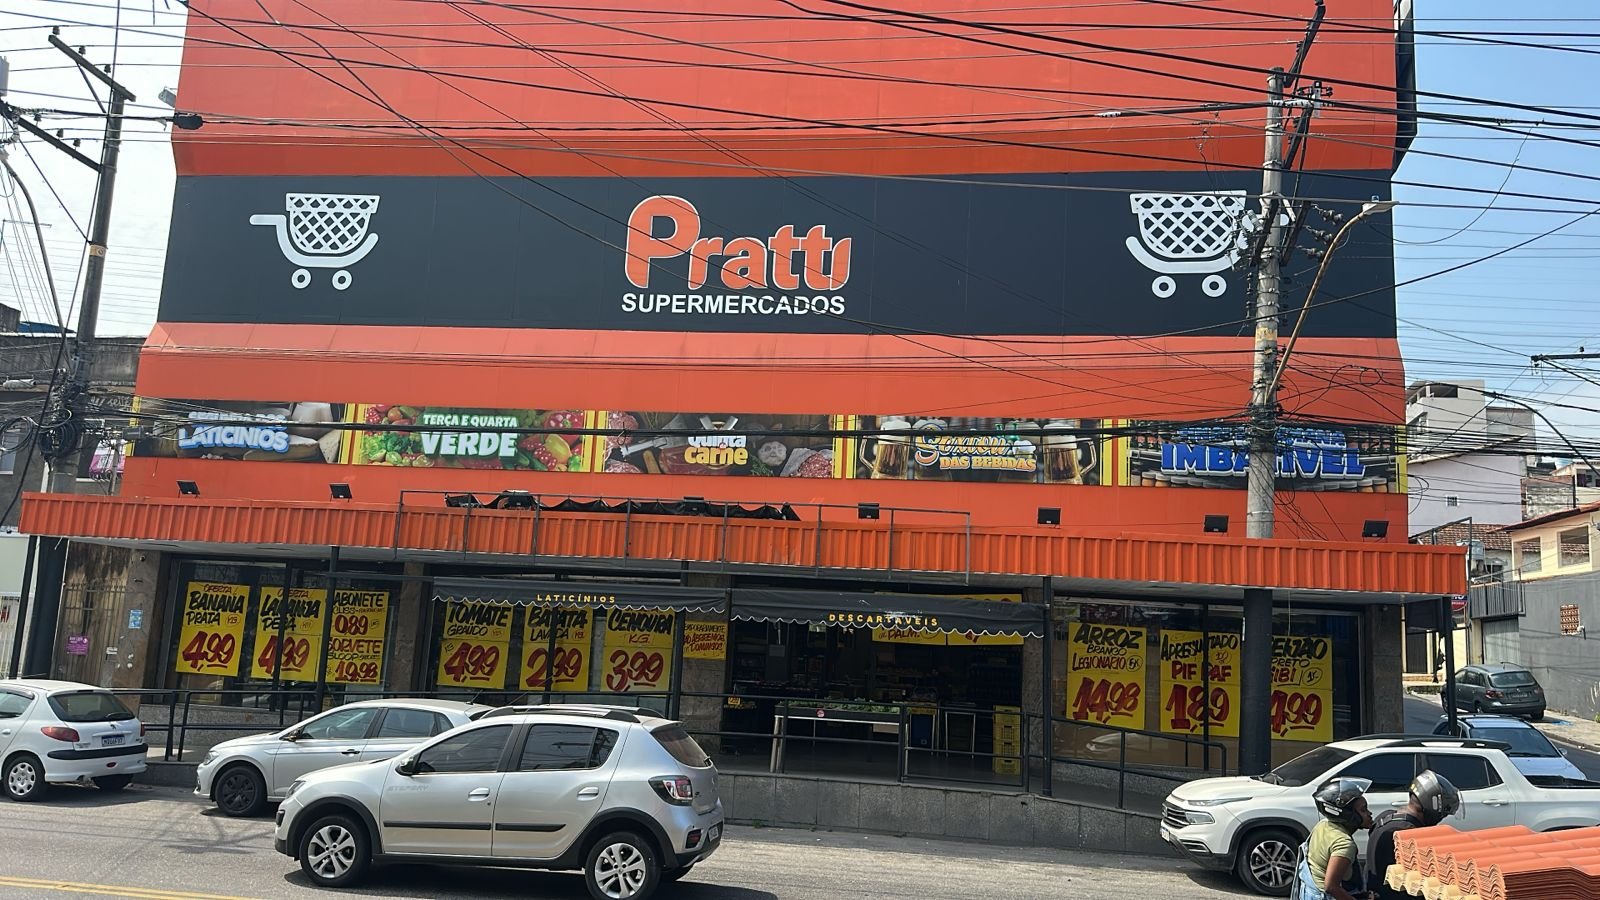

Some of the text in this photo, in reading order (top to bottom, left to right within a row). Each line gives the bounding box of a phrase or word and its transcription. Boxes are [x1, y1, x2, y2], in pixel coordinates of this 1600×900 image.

[625, 195, 852, 291] Pratti
[621, 292, 846, 315] SUPERMERCADOS
[423, 414, 518, 428] TERÇA E QUARTA
[420, 432, 519, 457] VERDE
[940, 455, 1037, 472] DAS BEBIDAS
[189, 591, 245, 613] BANANA
[260, 594, 321, 618] LAANJA
[333, 592, 385, 607] ABONETE
[537, 594, 616, 602] LATICÍNIOS
[186, 611, 220, 625] PRATA
[448, 601, 511, 627] TOMATE
[608, 608, 673, 635] CENOURA
[530, 628, 569, 641] LAVDA
[1073, 624, 1142, 649] ARROZ
[182, 631, 236, 672] 4,99
[1087, 644, 1127, 656] BRANCO
[1161, 634, 1238, 661] APRESUTADO
[1272, 637, 1328, 660] EIJÃO
[444, 642, 499, 682] 4,99
[606, 650, 664, 692] 3,99
[1172, 660, 1197, 680] PIF
[1072, 677, 1141, 724] 14,98
